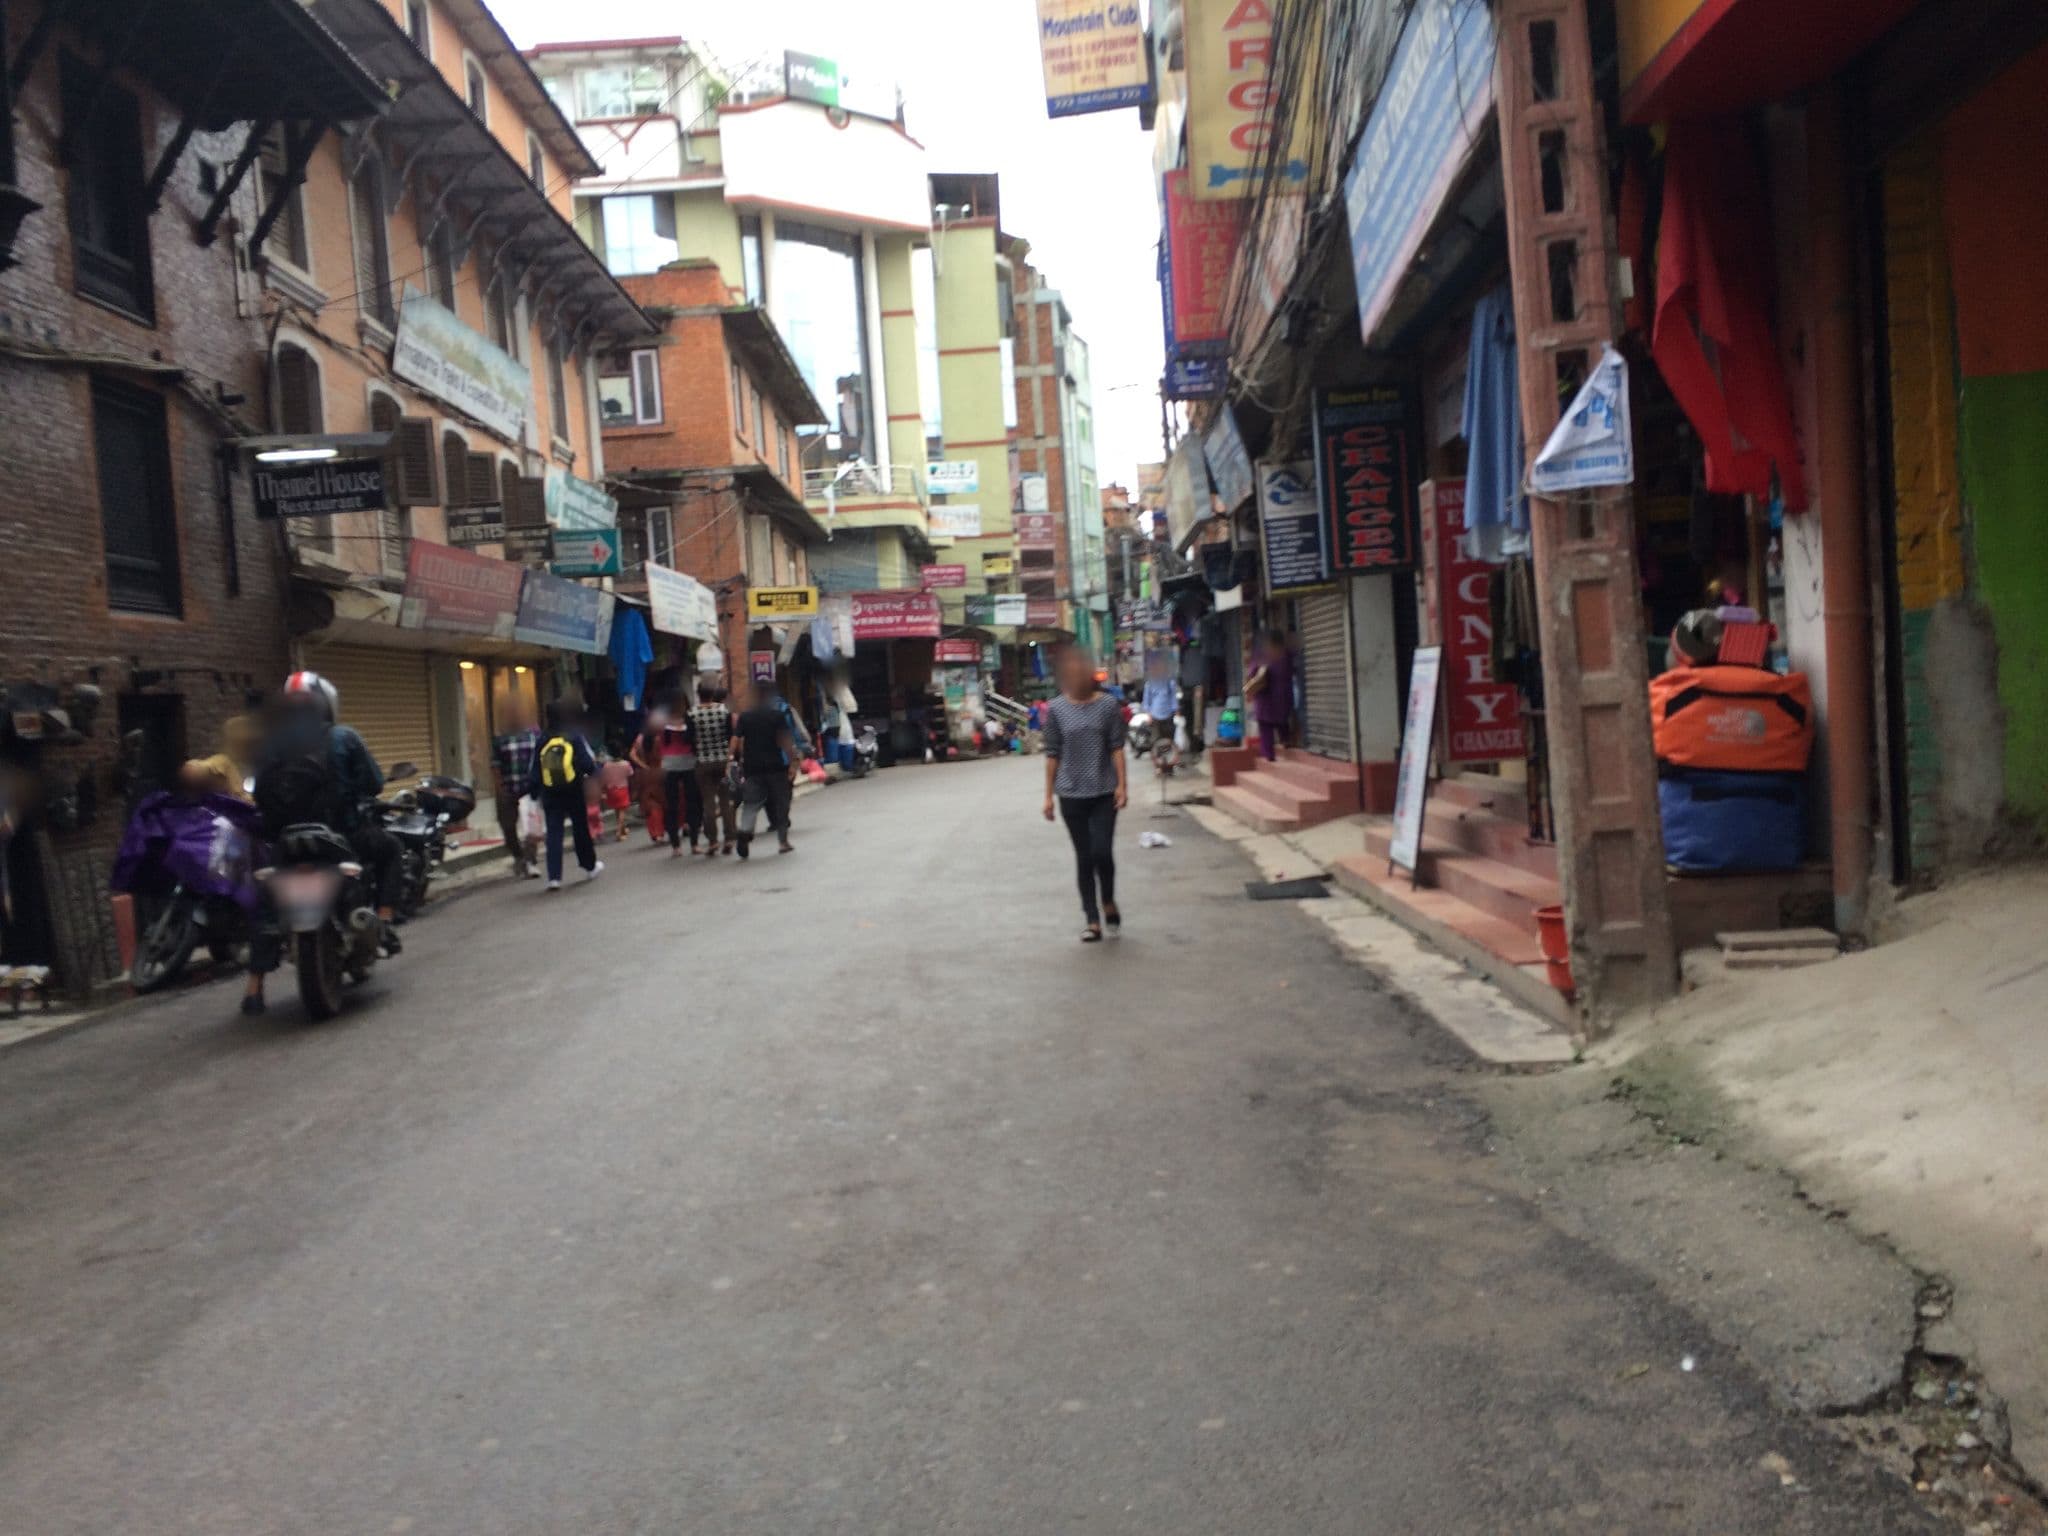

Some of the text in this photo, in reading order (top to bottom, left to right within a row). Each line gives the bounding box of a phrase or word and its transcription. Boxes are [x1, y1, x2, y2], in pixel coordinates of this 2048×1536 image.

[1043, 5, 1137, 37] Mountain Club
[256, 466, 380, 500] Thamel House
[1344, 426, 1396, 568] CHANGER
[1455, 729, 1524, 752] CHANGER
